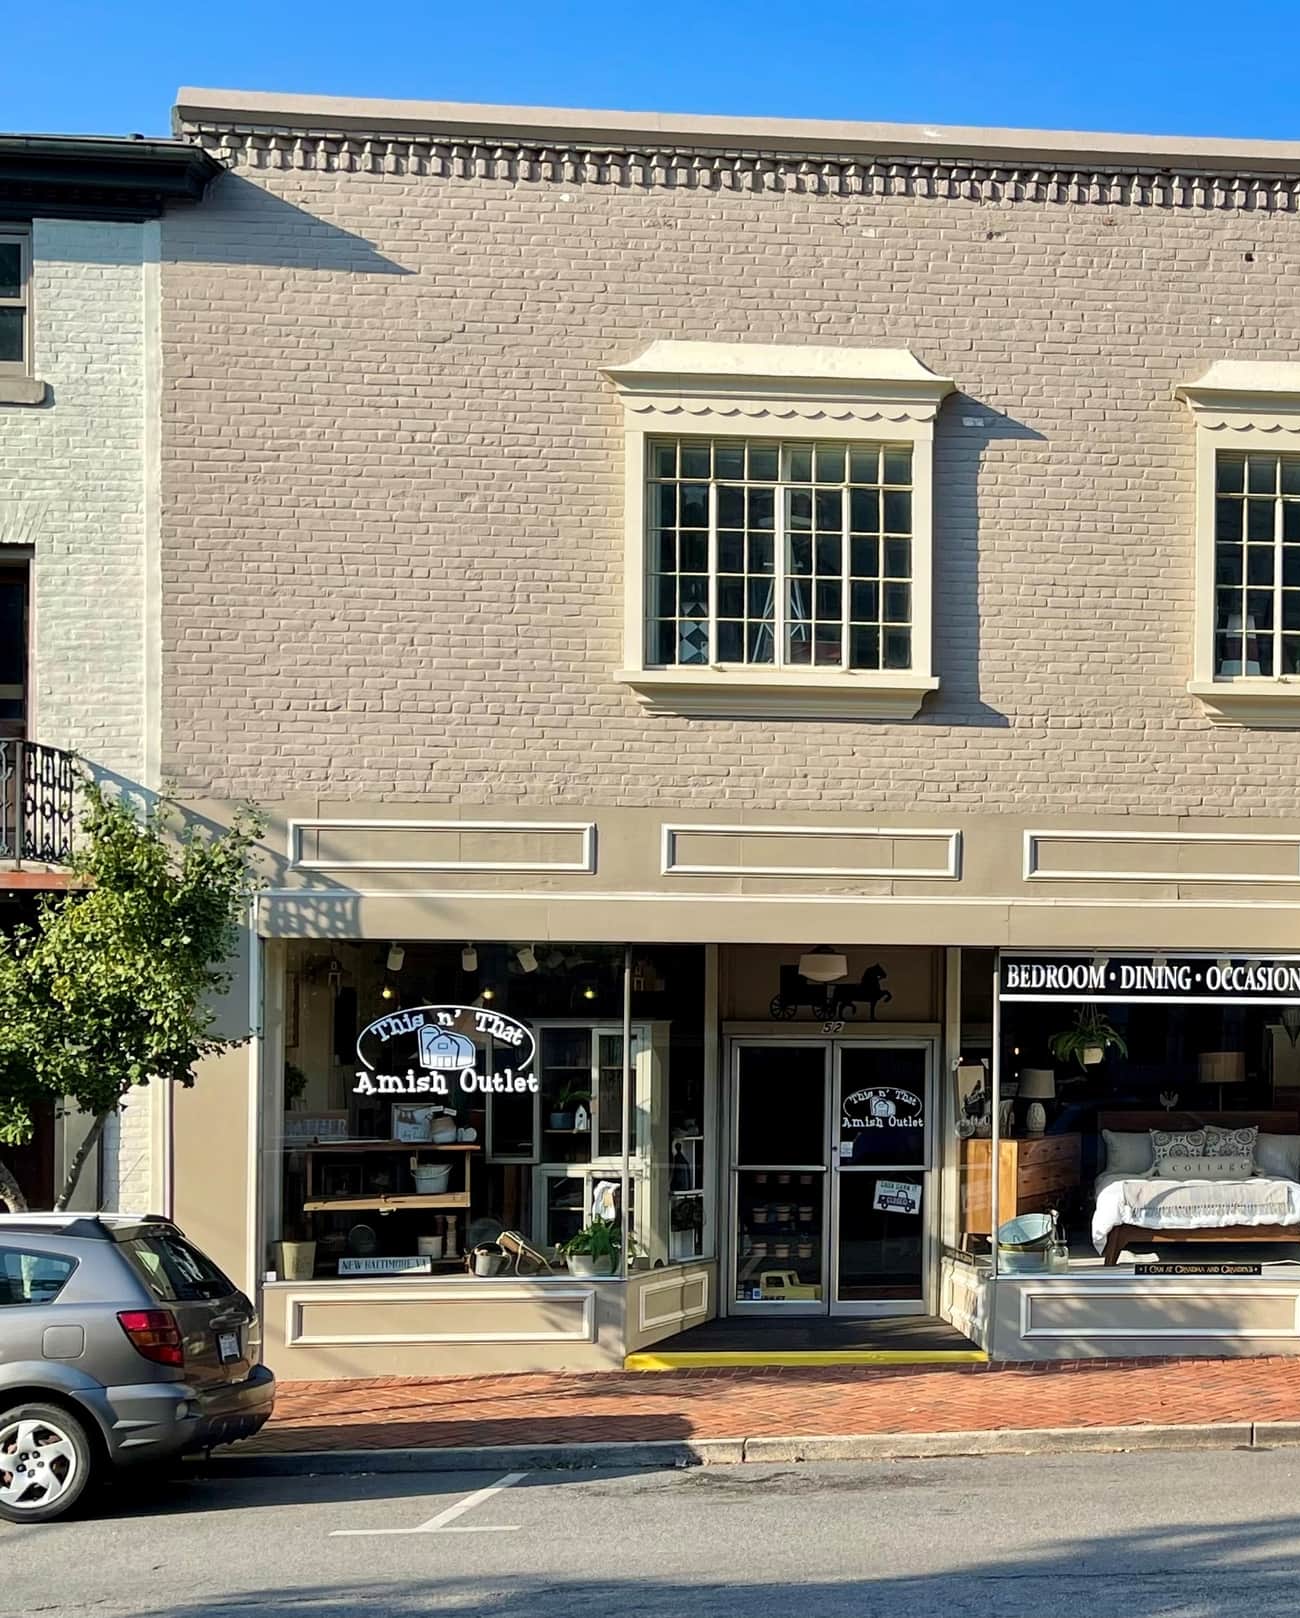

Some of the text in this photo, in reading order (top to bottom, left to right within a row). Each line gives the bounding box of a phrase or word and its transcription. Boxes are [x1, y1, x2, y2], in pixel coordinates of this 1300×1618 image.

[1006, 964, 1105, 989] BEDROOM
[1120, 966, 1193, 991] DINING
[370, 1012, 425, 1042] This
[475, 1012, 526, 1046] That
[822, 1021, 844, 1033] 52
[353, 1068, 539, 1095] Amish Outlet
[848, 1090, 874, 1105] This
[895, 1090, 917, 1106] That
[841, 1114, 924, 1129] Amish Outlet
[342, 1259, 362, 1270] NEW
